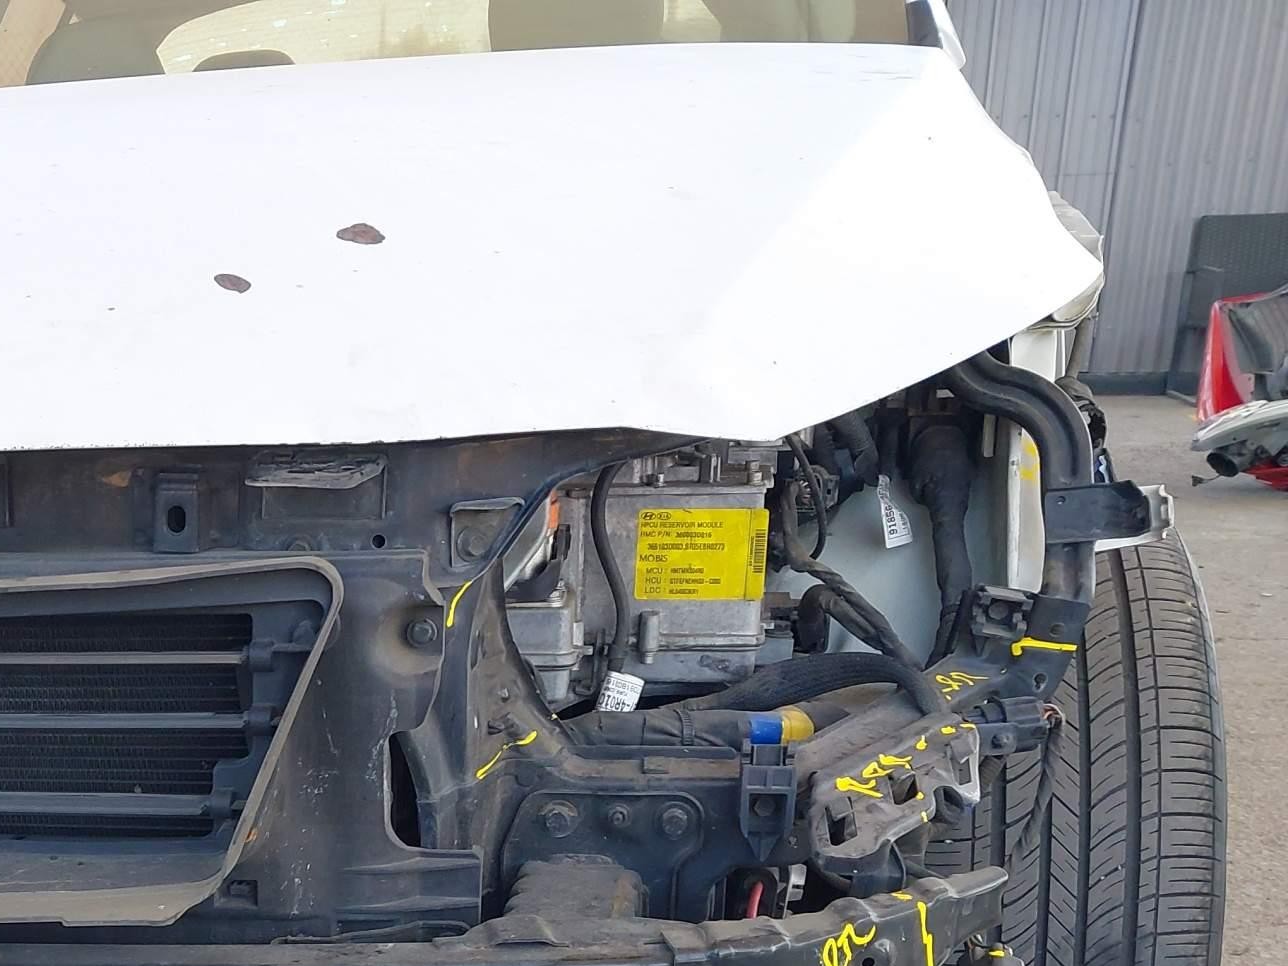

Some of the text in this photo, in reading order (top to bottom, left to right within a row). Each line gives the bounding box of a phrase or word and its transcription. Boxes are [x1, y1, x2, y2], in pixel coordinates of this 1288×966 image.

[660, 521, 696, 529] RESERVOIR
[697, 521, 724, 529] MODULE
[639, 554, 669, 562] MOBIS
[646, 567, 663, 575] MCU
